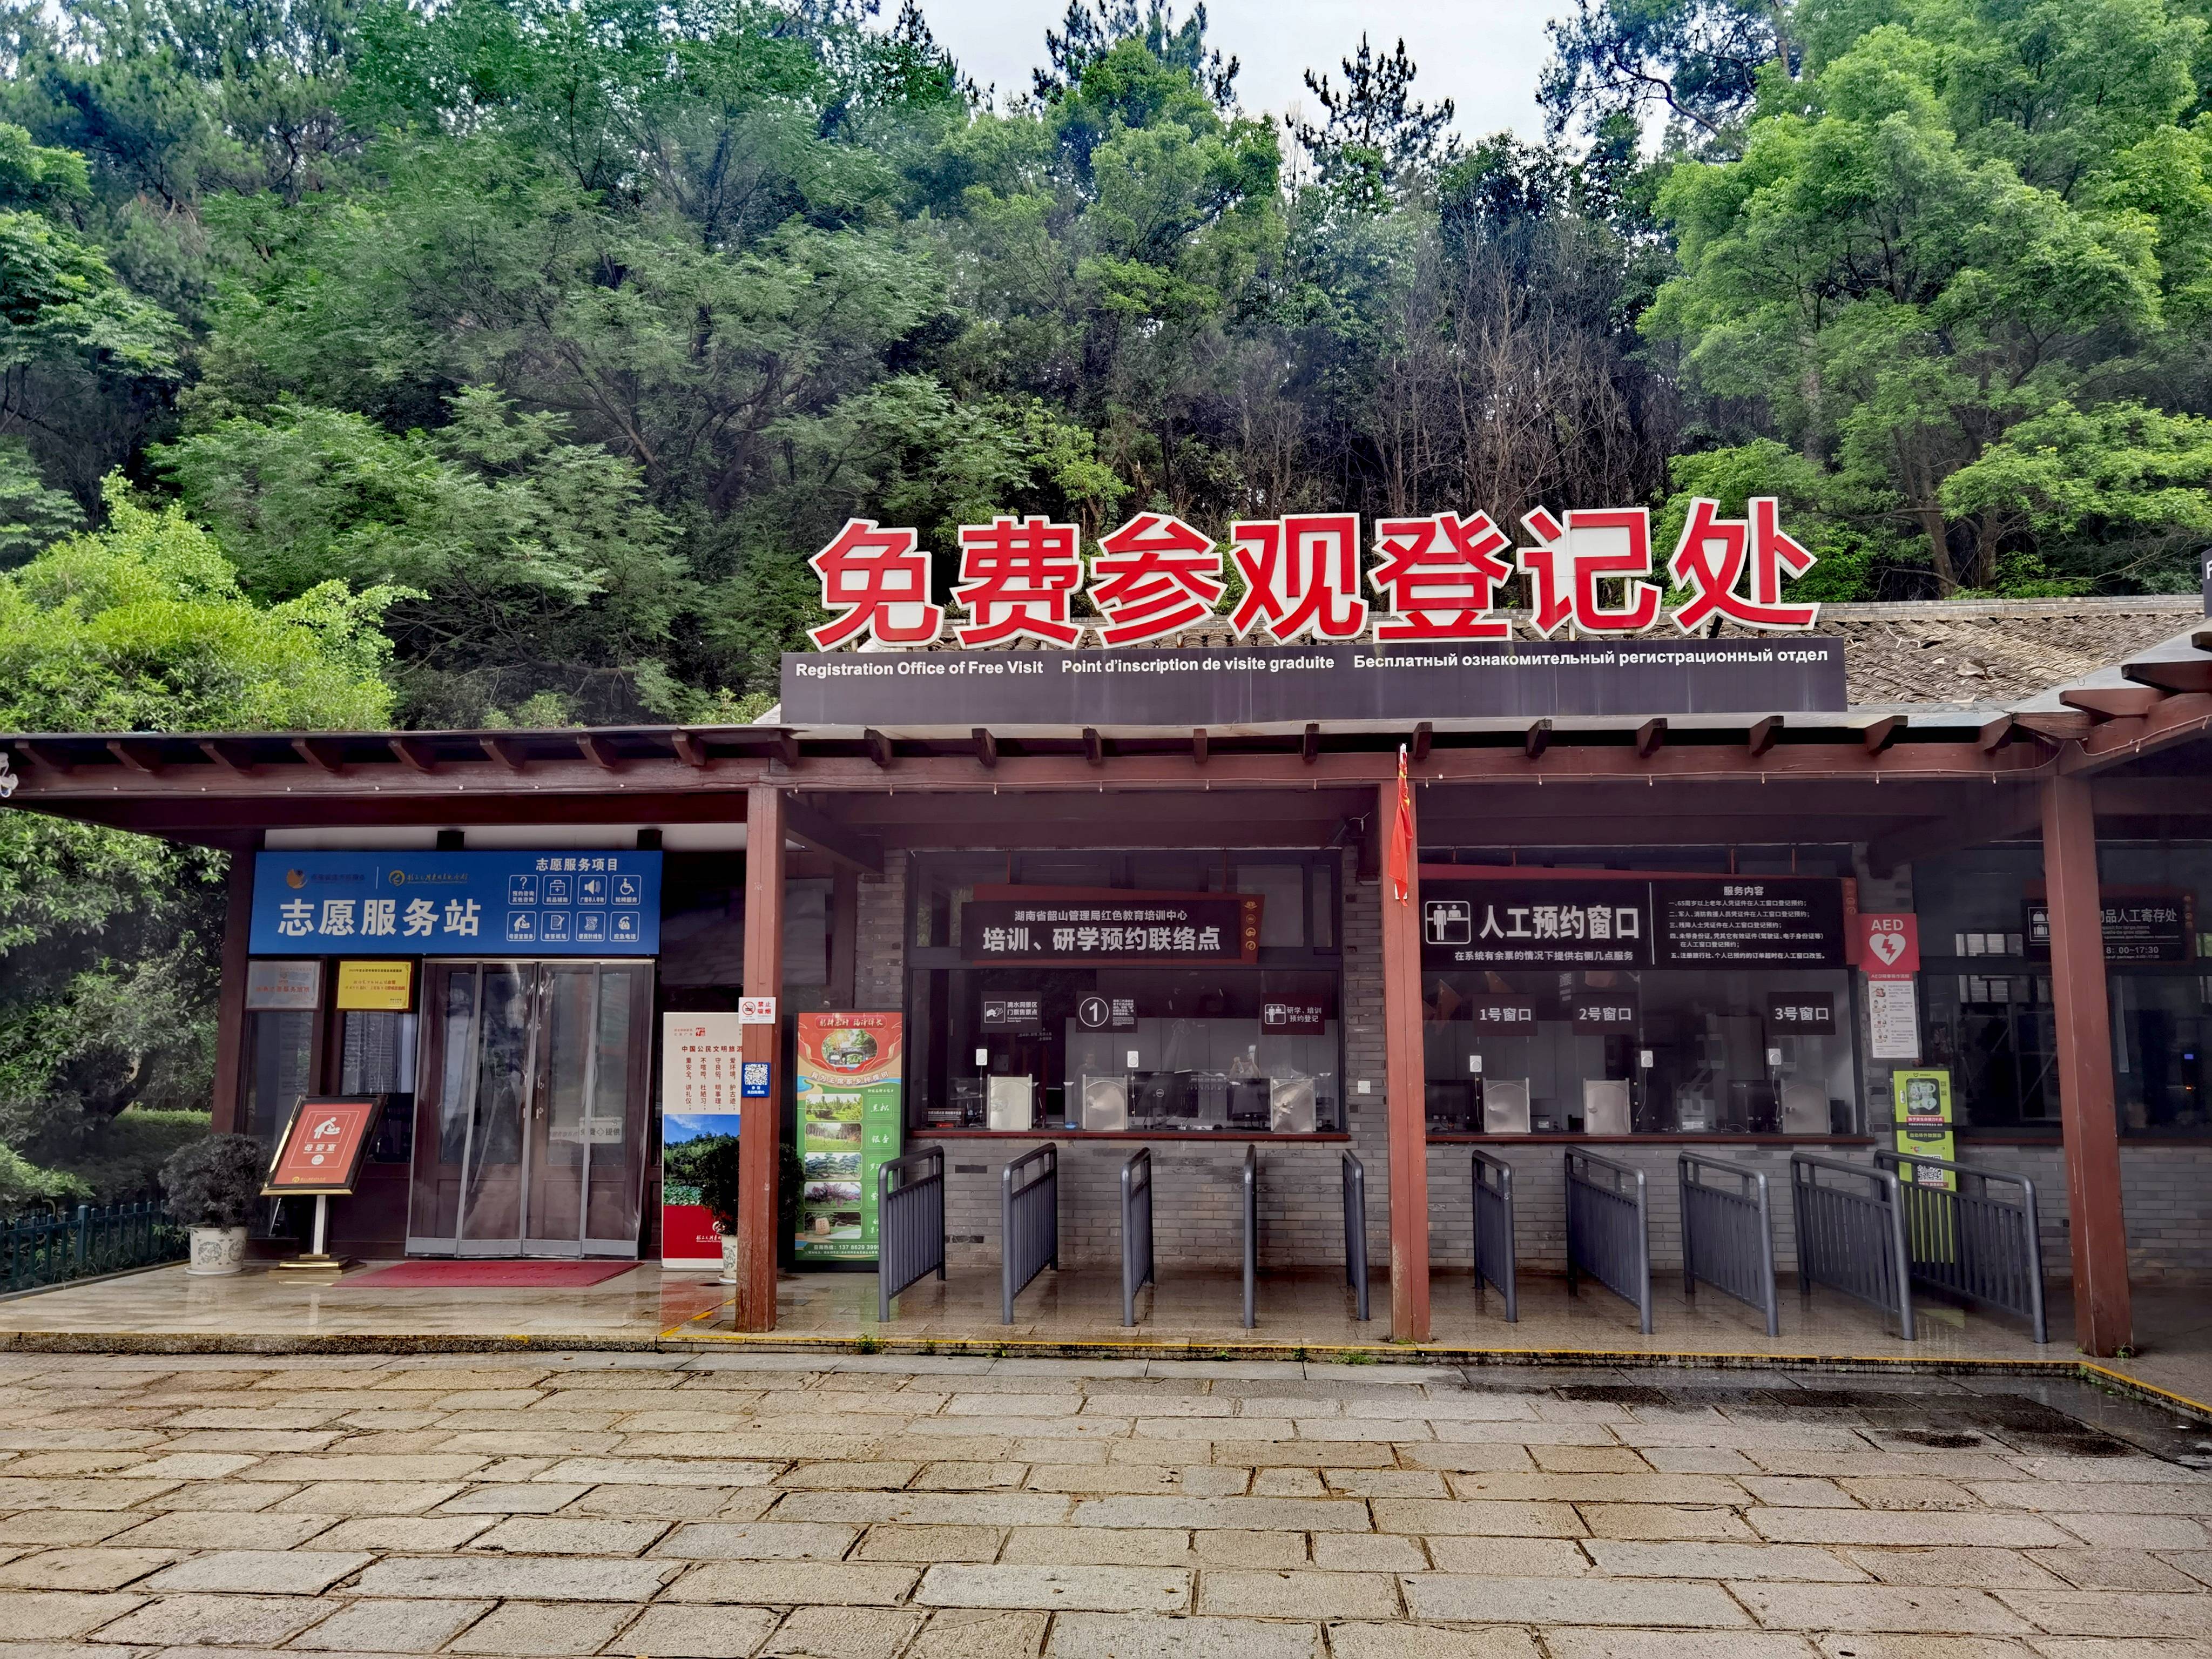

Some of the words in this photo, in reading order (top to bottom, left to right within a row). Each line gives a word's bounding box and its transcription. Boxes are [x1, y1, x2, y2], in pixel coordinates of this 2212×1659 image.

[808, 496, 1818, 651] 免费参观登记处
[1062, 660, 1102, 672] Point
[1105, 658, 1199, 675] d'inscription
[1203, 658, 1220, 670] de
[1224, 657, 1266, 670] visite
[1270, 656, 1334, 673] graduite
[1354, 653, 1458, 667] Бесплатный
[1462, 651, 1615, 665] ознакомительный
[1620, 650, 1773, 666] регистрационный
[1777, 650, 1827, 663] отдел
[796, 663, 894, 679] Registration
[898, 662, 945, 675] Office
[949, 661, 966, 674] of
[969, 662, 1003, 673] Free
[1007, 661, 1043, 673] Visit
[536, 858, 617, 871] 志愿服务项目
[1724, 886, 1764, 896] 服务内容
[278, 898, 481, 936] 志愿服务站
[1015, 910, 1188, 921] 湖南省韶山管理局红色教育培训中心
[1479, 905, 1640, 939] 人工预约窗口
[1871, 919, 1904, 931] AED
[983, 927, 1220, 952] 培训、研学预约联络点
[1455, 950, 1634, 961] 在系统有余票的情况下提供右侧几点服务
[1089, 1002, 1098, 1022] 1
[1480, 1007, 1532, 1022] 1号窗口
[1579, 1007, 1631, 1021] 2号窗口
[1775, 1007, 1829, 1021] 3号窗口
[871, 1134, 889, 1143] 银杏
[304, 1143, 336, 1151] 母婴室
